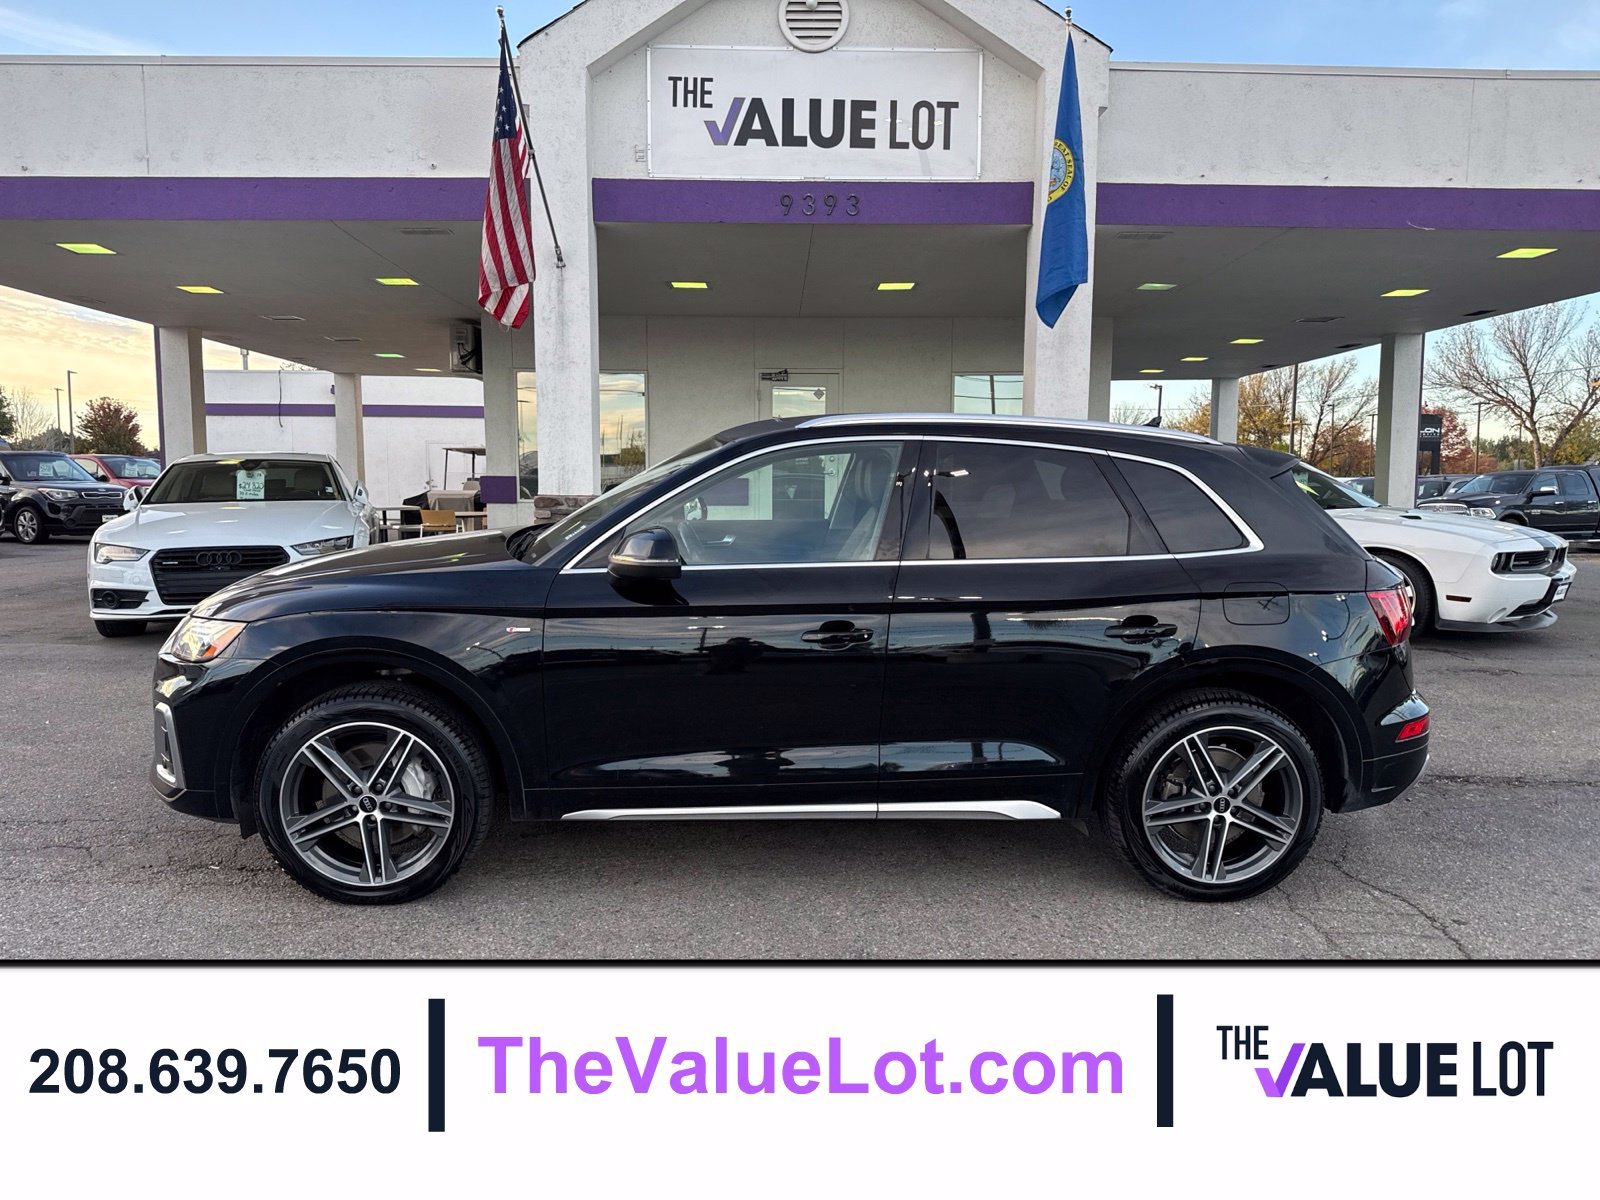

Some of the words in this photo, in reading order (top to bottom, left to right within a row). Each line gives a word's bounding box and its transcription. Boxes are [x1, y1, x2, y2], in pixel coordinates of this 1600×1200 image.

[668, 76, 714, 108] THE
[703, 97, 877, 149] VALUE
[889, 100, 959, 150] LOT
[780, 193, 859, 216] 9393
